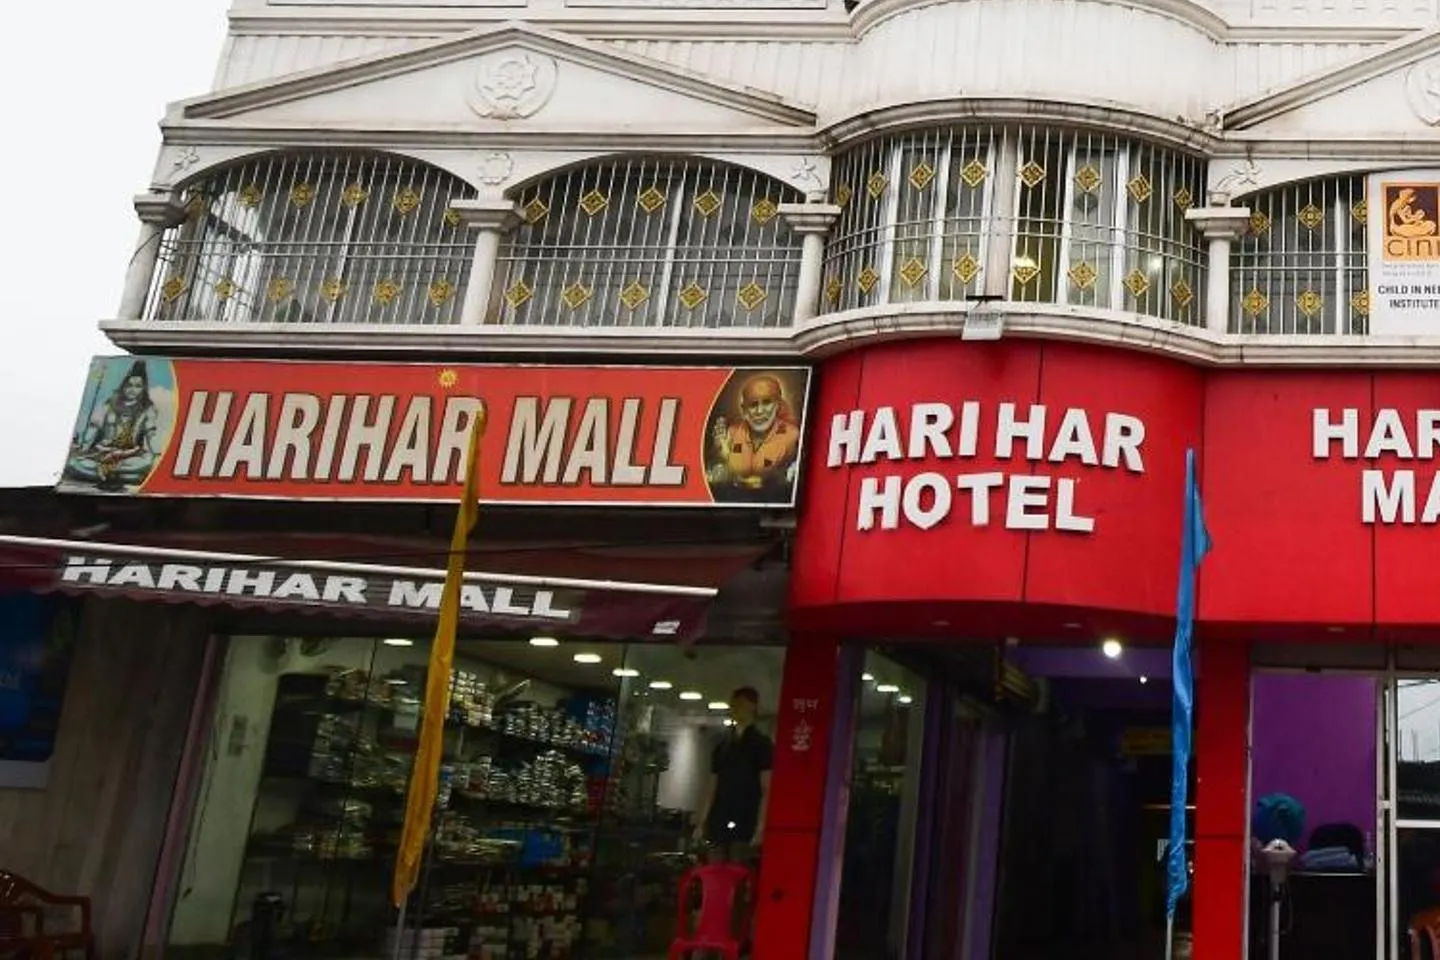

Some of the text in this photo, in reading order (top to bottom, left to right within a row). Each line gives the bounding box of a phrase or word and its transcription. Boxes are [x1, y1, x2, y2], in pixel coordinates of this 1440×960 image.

[1378, 284, 1408, 295] CHILD
[1411, 284, 1421, 295] IN
[1389, 299, 1440, 309] INSTITUTE
[173, 390, 687, 486] HARIHAR MALL
[856, 471, 1096, 532] HOTEL
[62, 555, 572, 619] HARIHAR MALL
